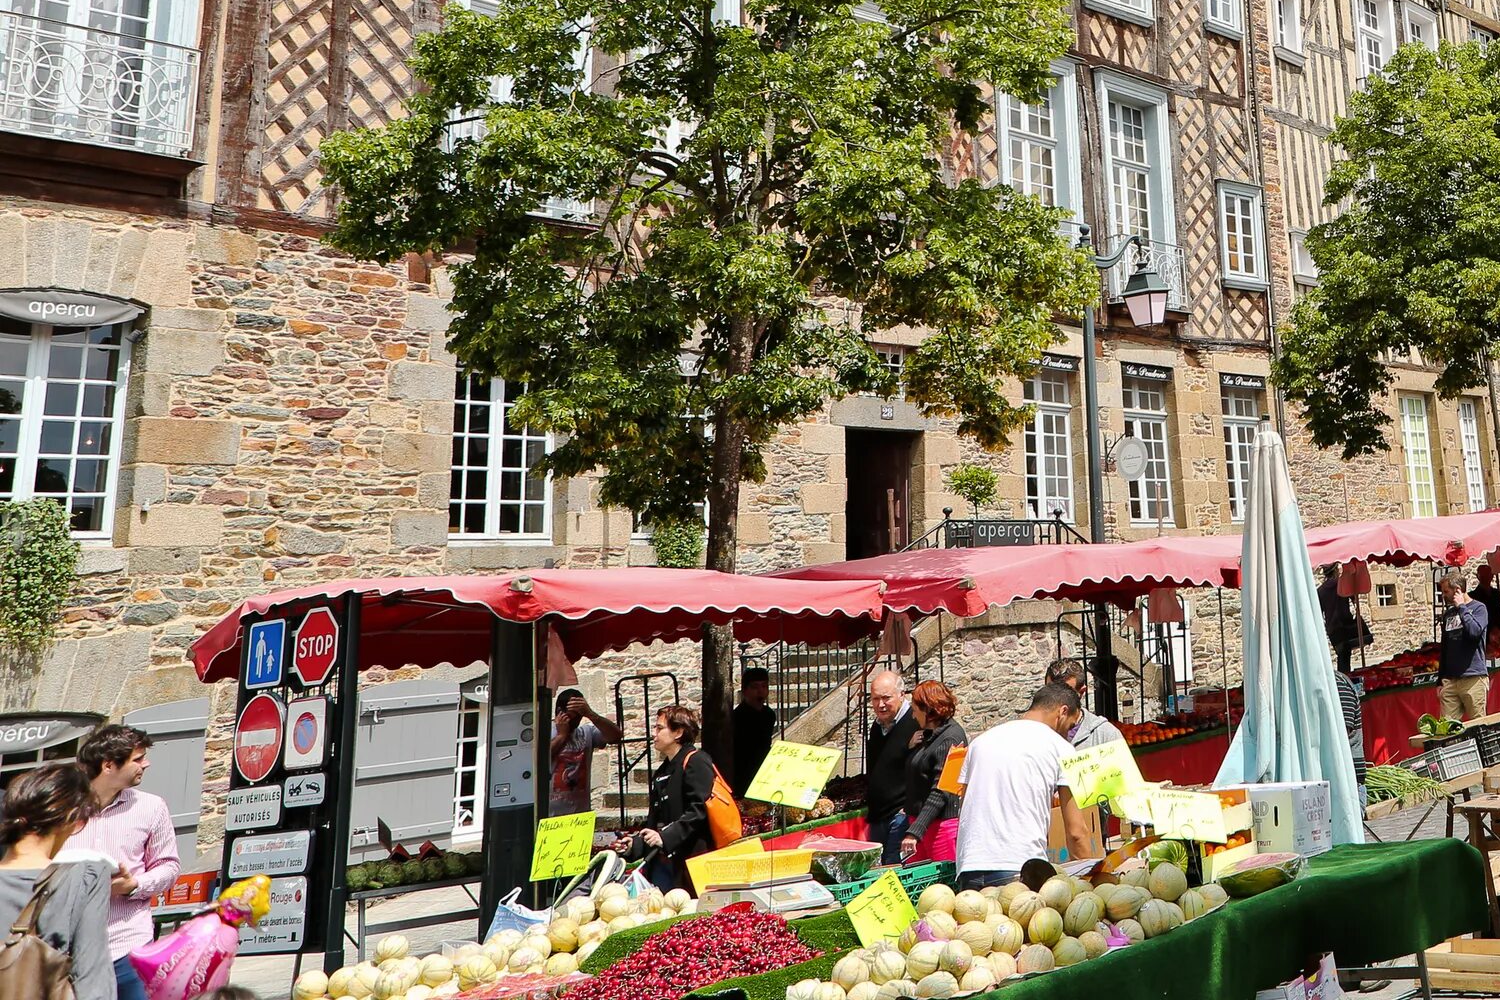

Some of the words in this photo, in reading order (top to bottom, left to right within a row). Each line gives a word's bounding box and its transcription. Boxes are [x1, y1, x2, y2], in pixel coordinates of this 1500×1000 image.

[28, 301, 96, 319] aperçu
[978, 523, 1030, 544] aperçu
[298, 634, 333, 659] STOP
[228, 797, 244, 806] SAUF
[246, 791, 280, 804] VÉHICULES
[1302, 795, 1326, 810] ISLAND
[234, 809, 271, 823] AUTORISÉS
[1307, 808, 1324, 822] CREST
[249, 861, 265, 871] basses
[270, 892, 293, 905] Rouge
[258, 934, 277, 944] mètre
